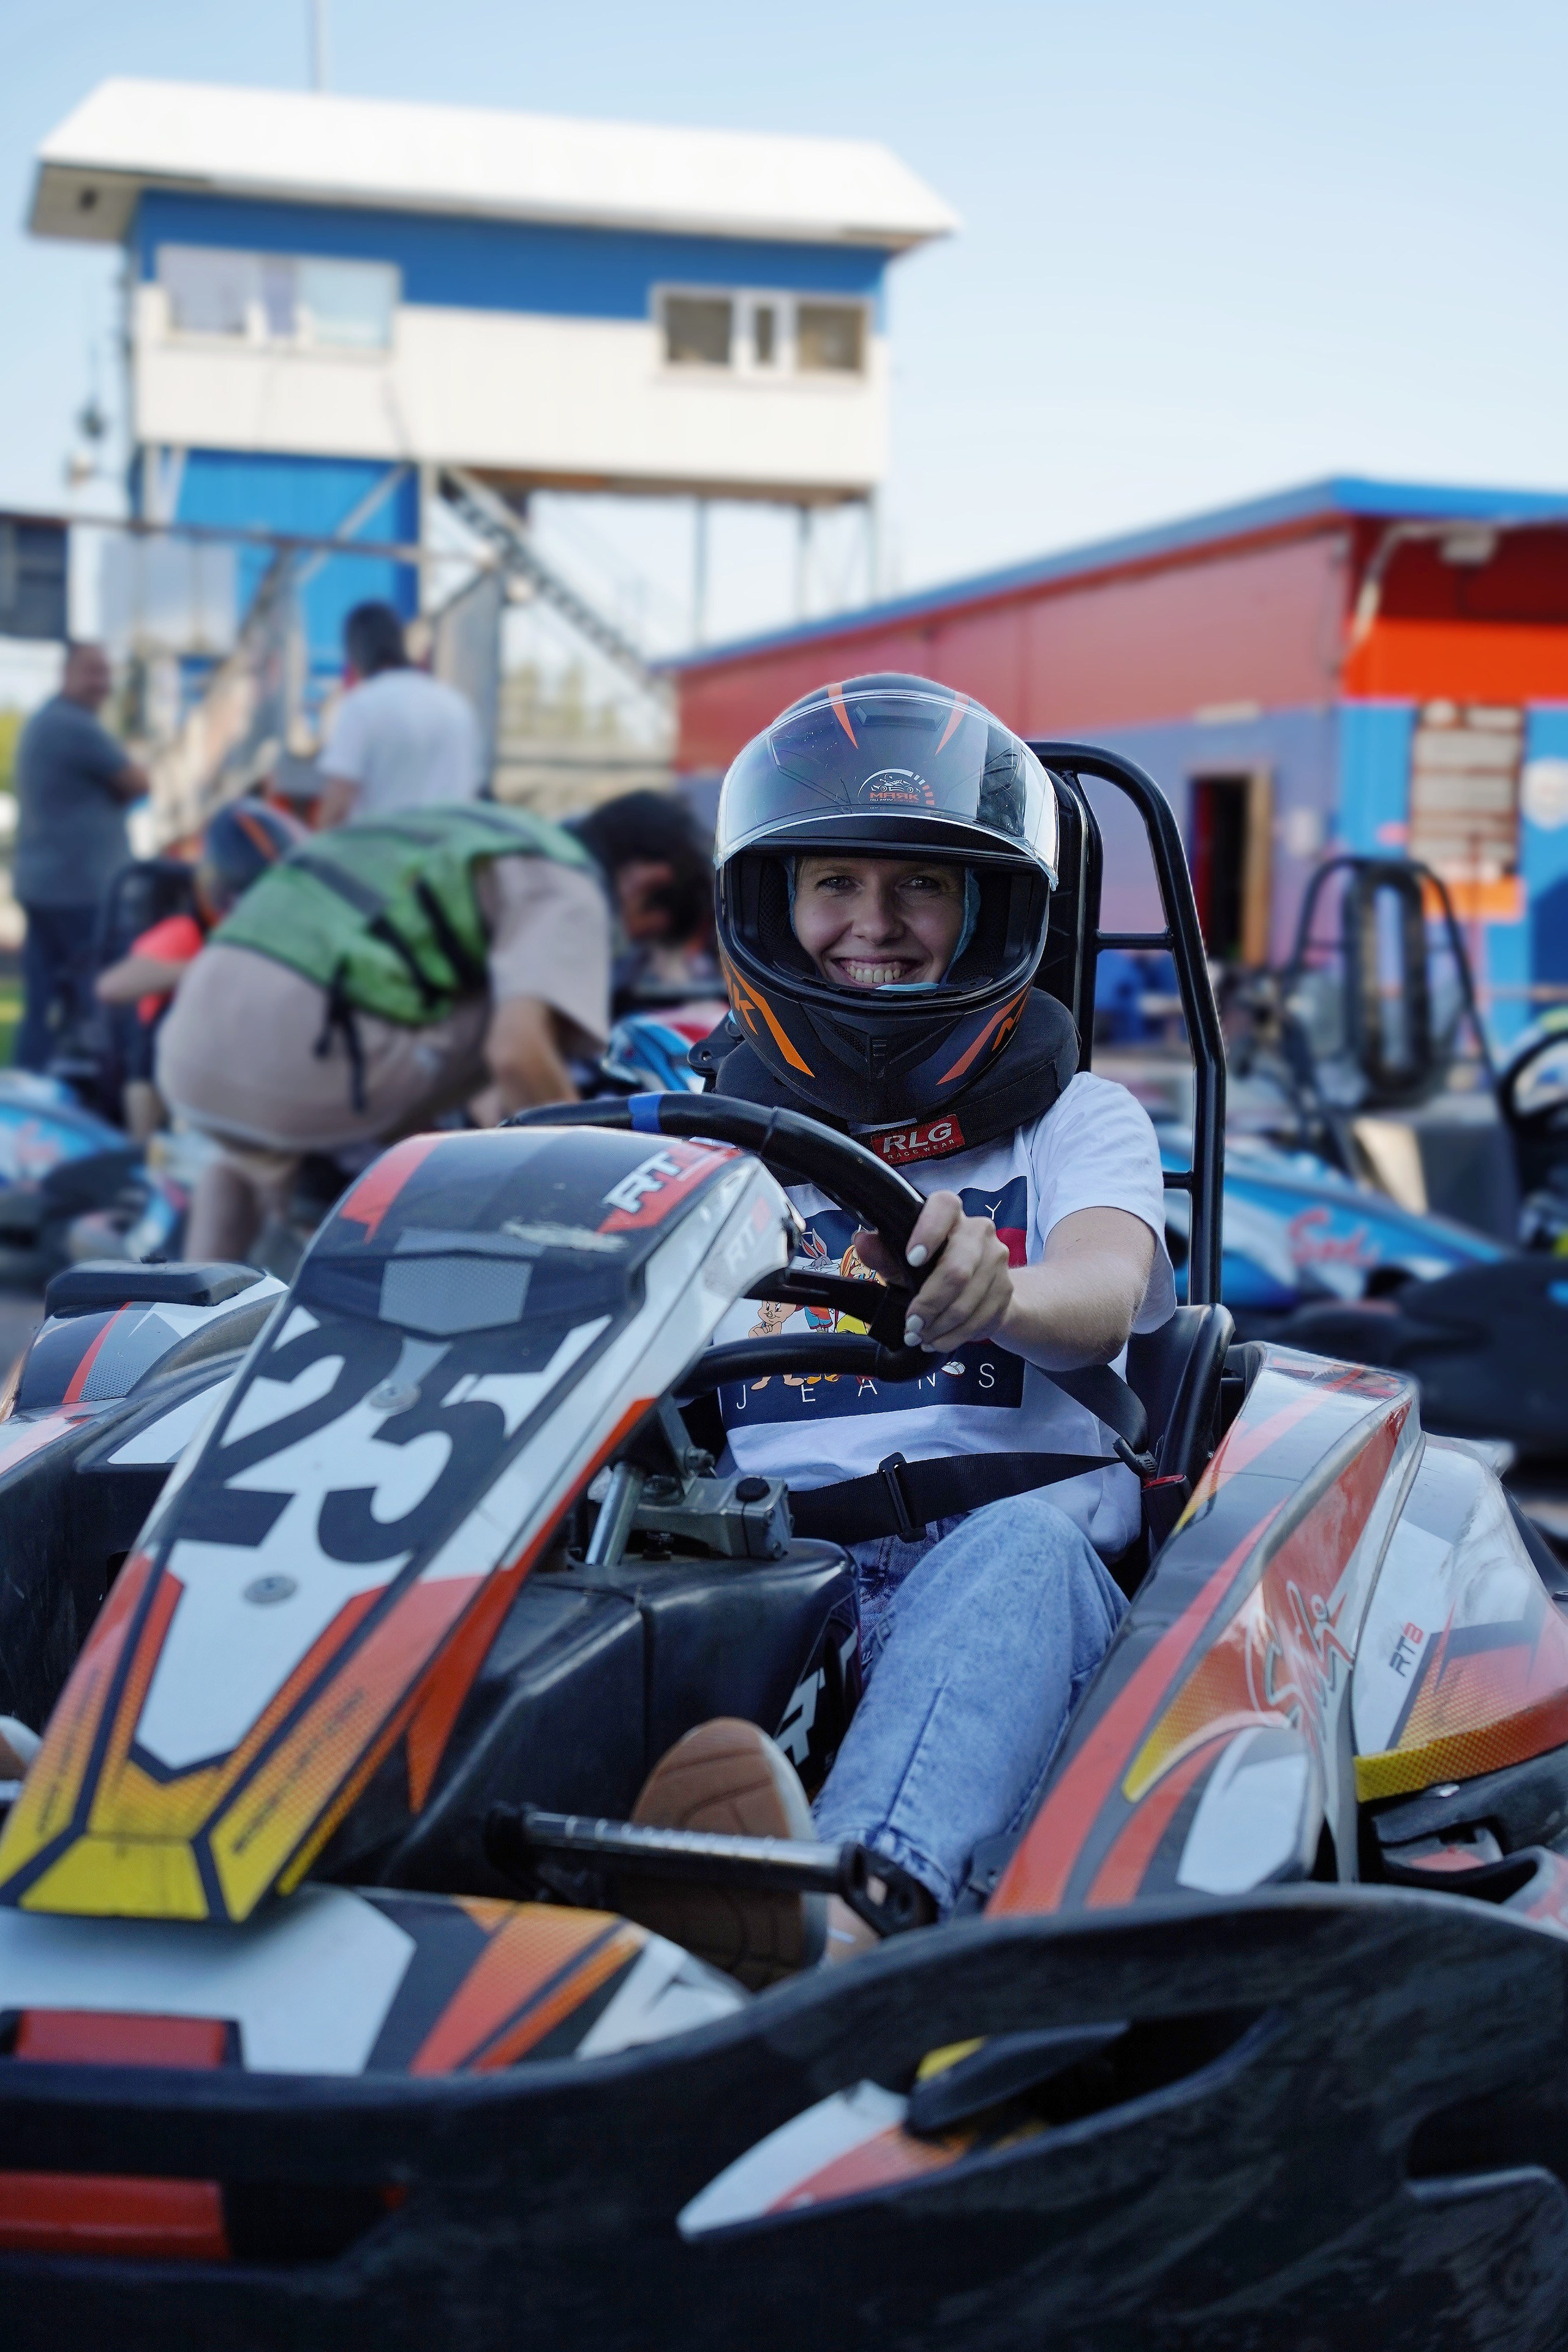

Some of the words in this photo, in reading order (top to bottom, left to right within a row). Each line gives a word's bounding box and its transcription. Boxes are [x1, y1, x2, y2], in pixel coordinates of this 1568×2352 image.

[883, 1122, 952, 1153] RLG
[888, 1150, 919, 1159] RACE
[923, 1139, 954, 1152] WEAR
[736, 1363, 996, 1411] JEANS
[175, 1317, 576, 1565] 25
[1388, 1622, 1425, 1677] RT8
